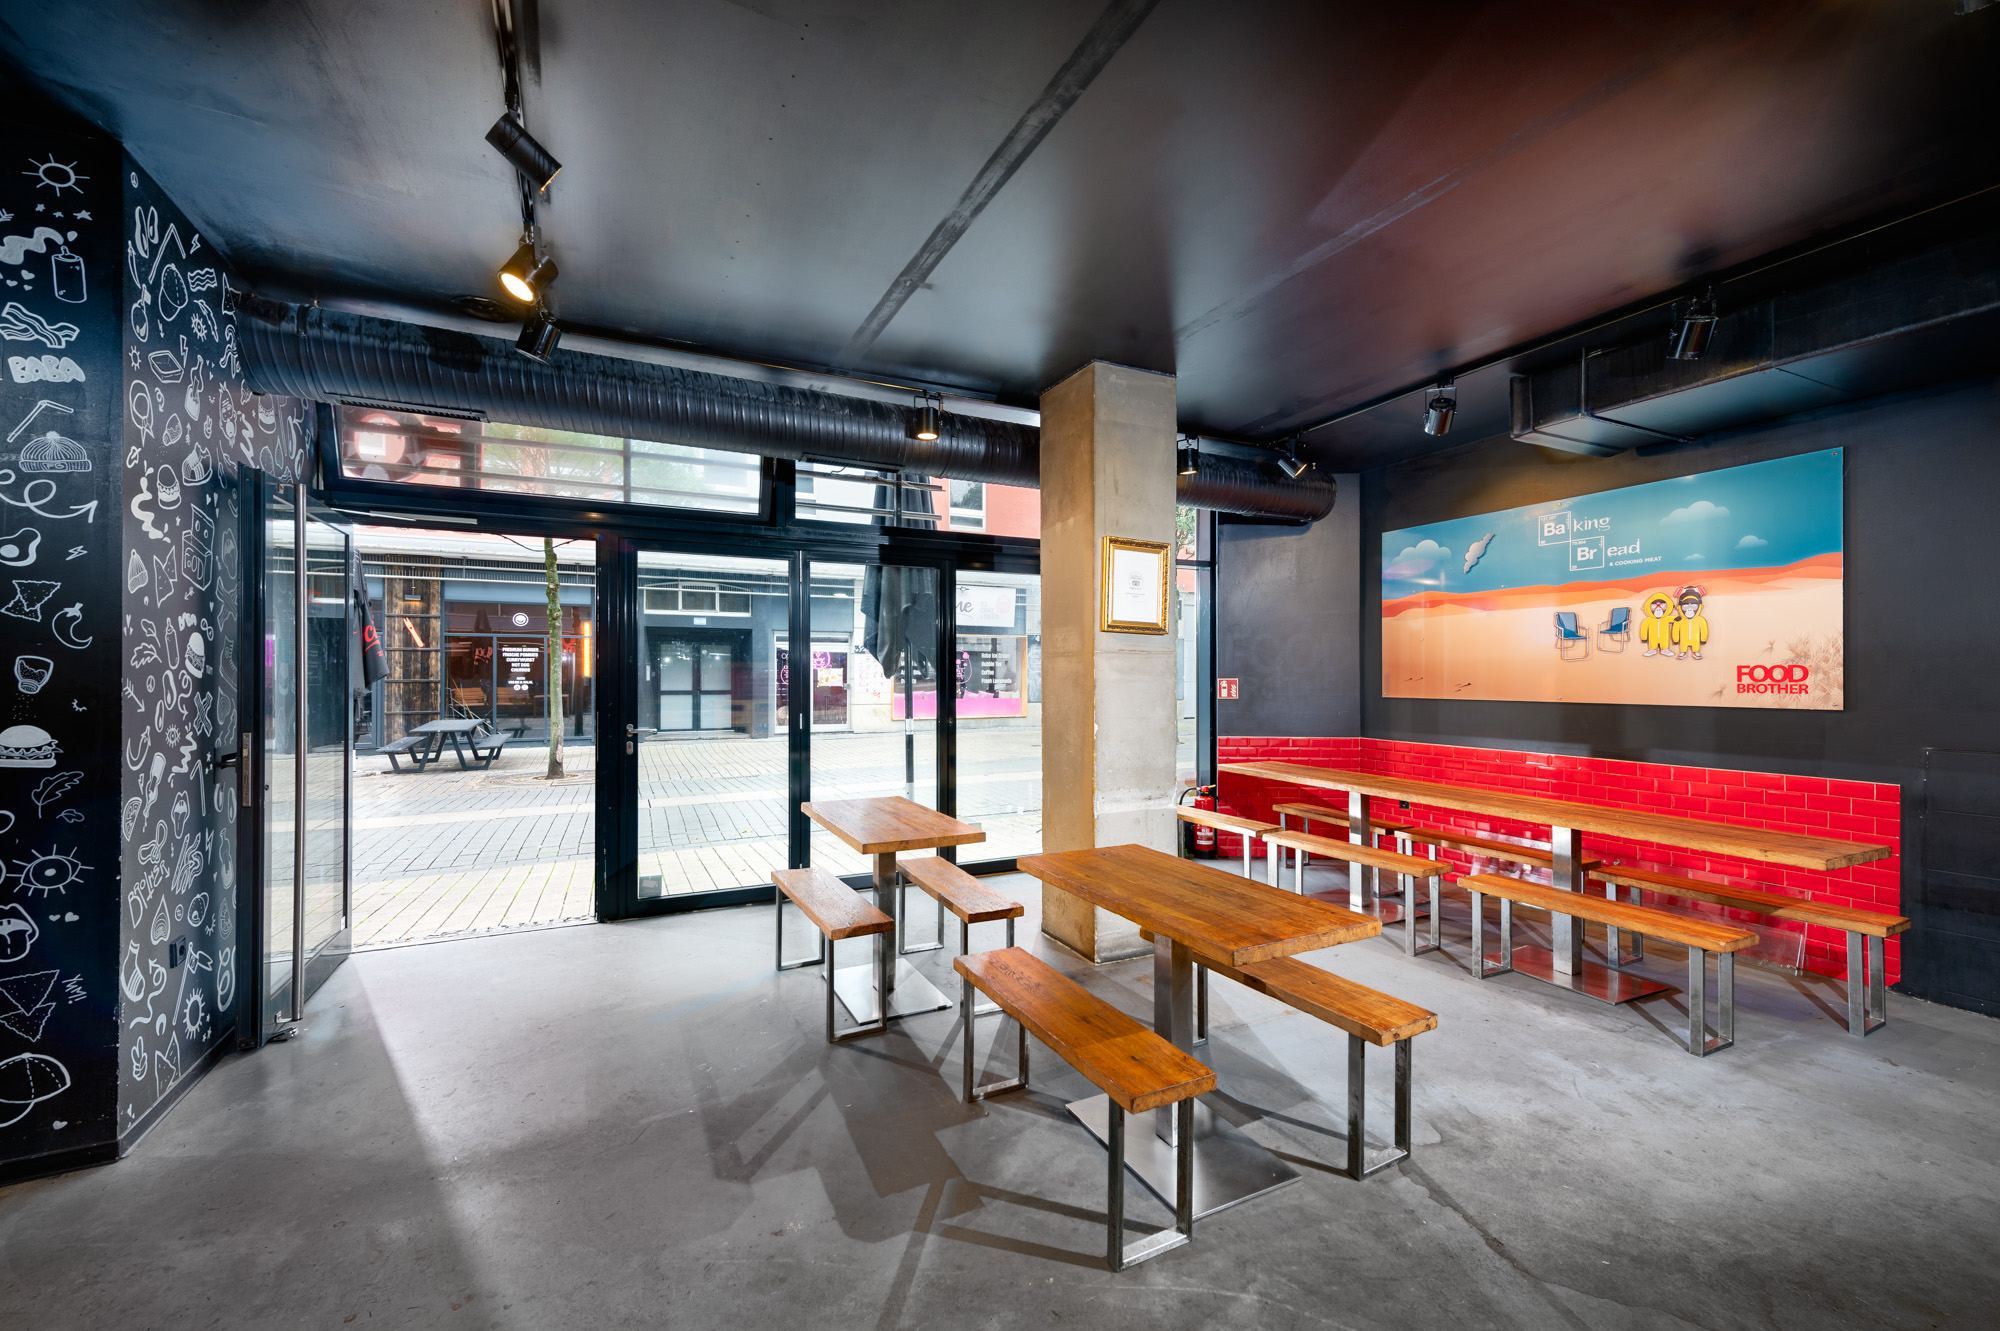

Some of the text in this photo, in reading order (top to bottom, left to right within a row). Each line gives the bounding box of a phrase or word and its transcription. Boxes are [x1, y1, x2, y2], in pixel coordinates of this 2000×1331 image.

[8, 355, 86, 383] BOBA
[1615, 558, 1643, 566] COOKING
[1737, 665, 1809, 683] FOOD
[1737, 684, 1809, 694] BROTHER
